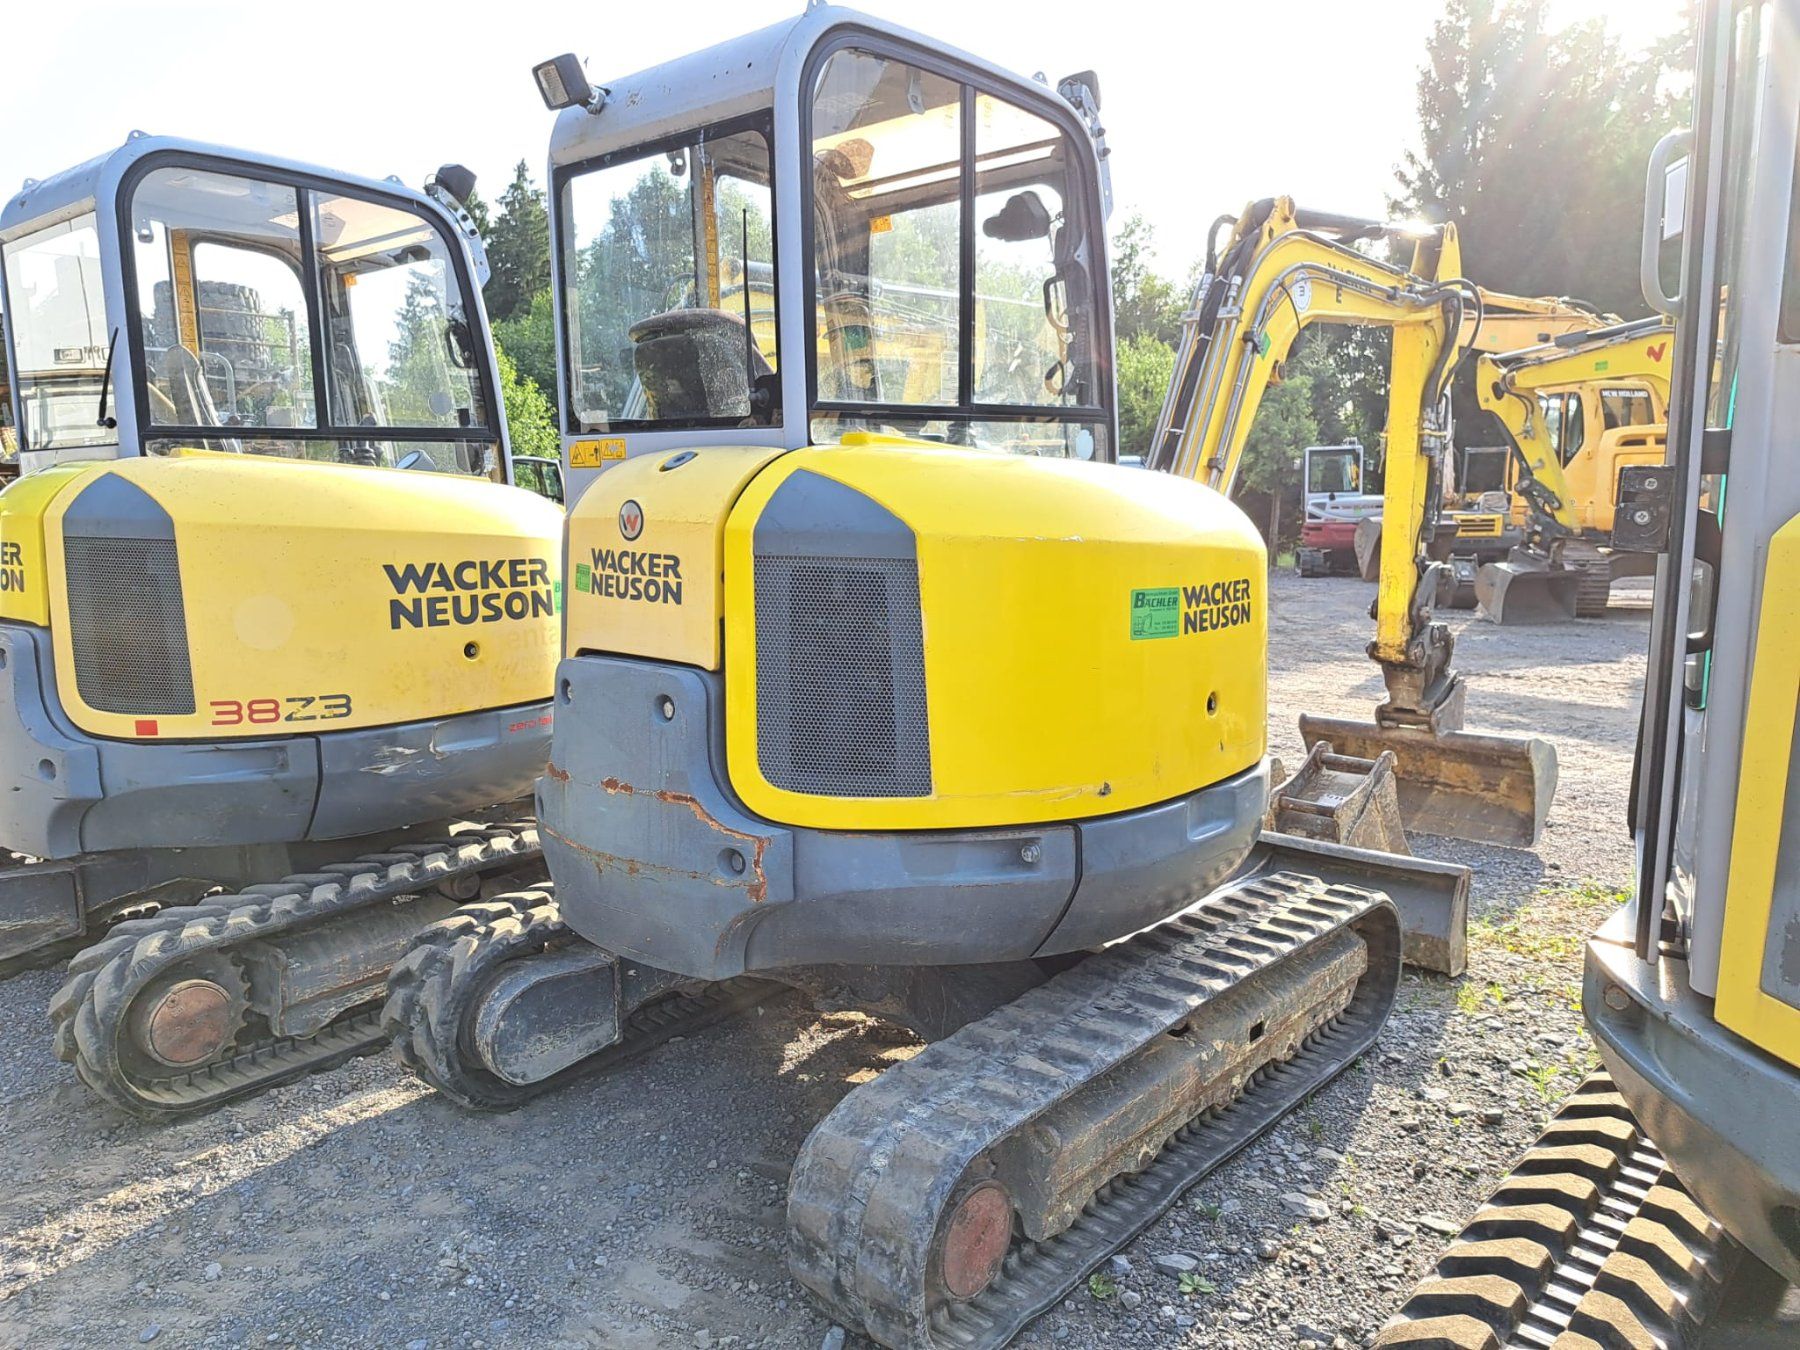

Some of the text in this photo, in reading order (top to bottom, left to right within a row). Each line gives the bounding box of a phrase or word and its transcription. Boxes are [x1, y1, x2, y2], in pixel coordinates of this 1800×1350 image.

[1619, 389, 1649, 397] HOLLAND
[382, 558, 551, 595] WACKER
[591, 548, 682, 580] WACKER
[591, 572, 682, 606] NEUSON
[1182, 578, 1251, 609] WACKER
[389, 589, 554, 630] NEUSON
[1184, 602, 1251, 635] NEUSON
[210, 693, 353, 726] 38Z3
